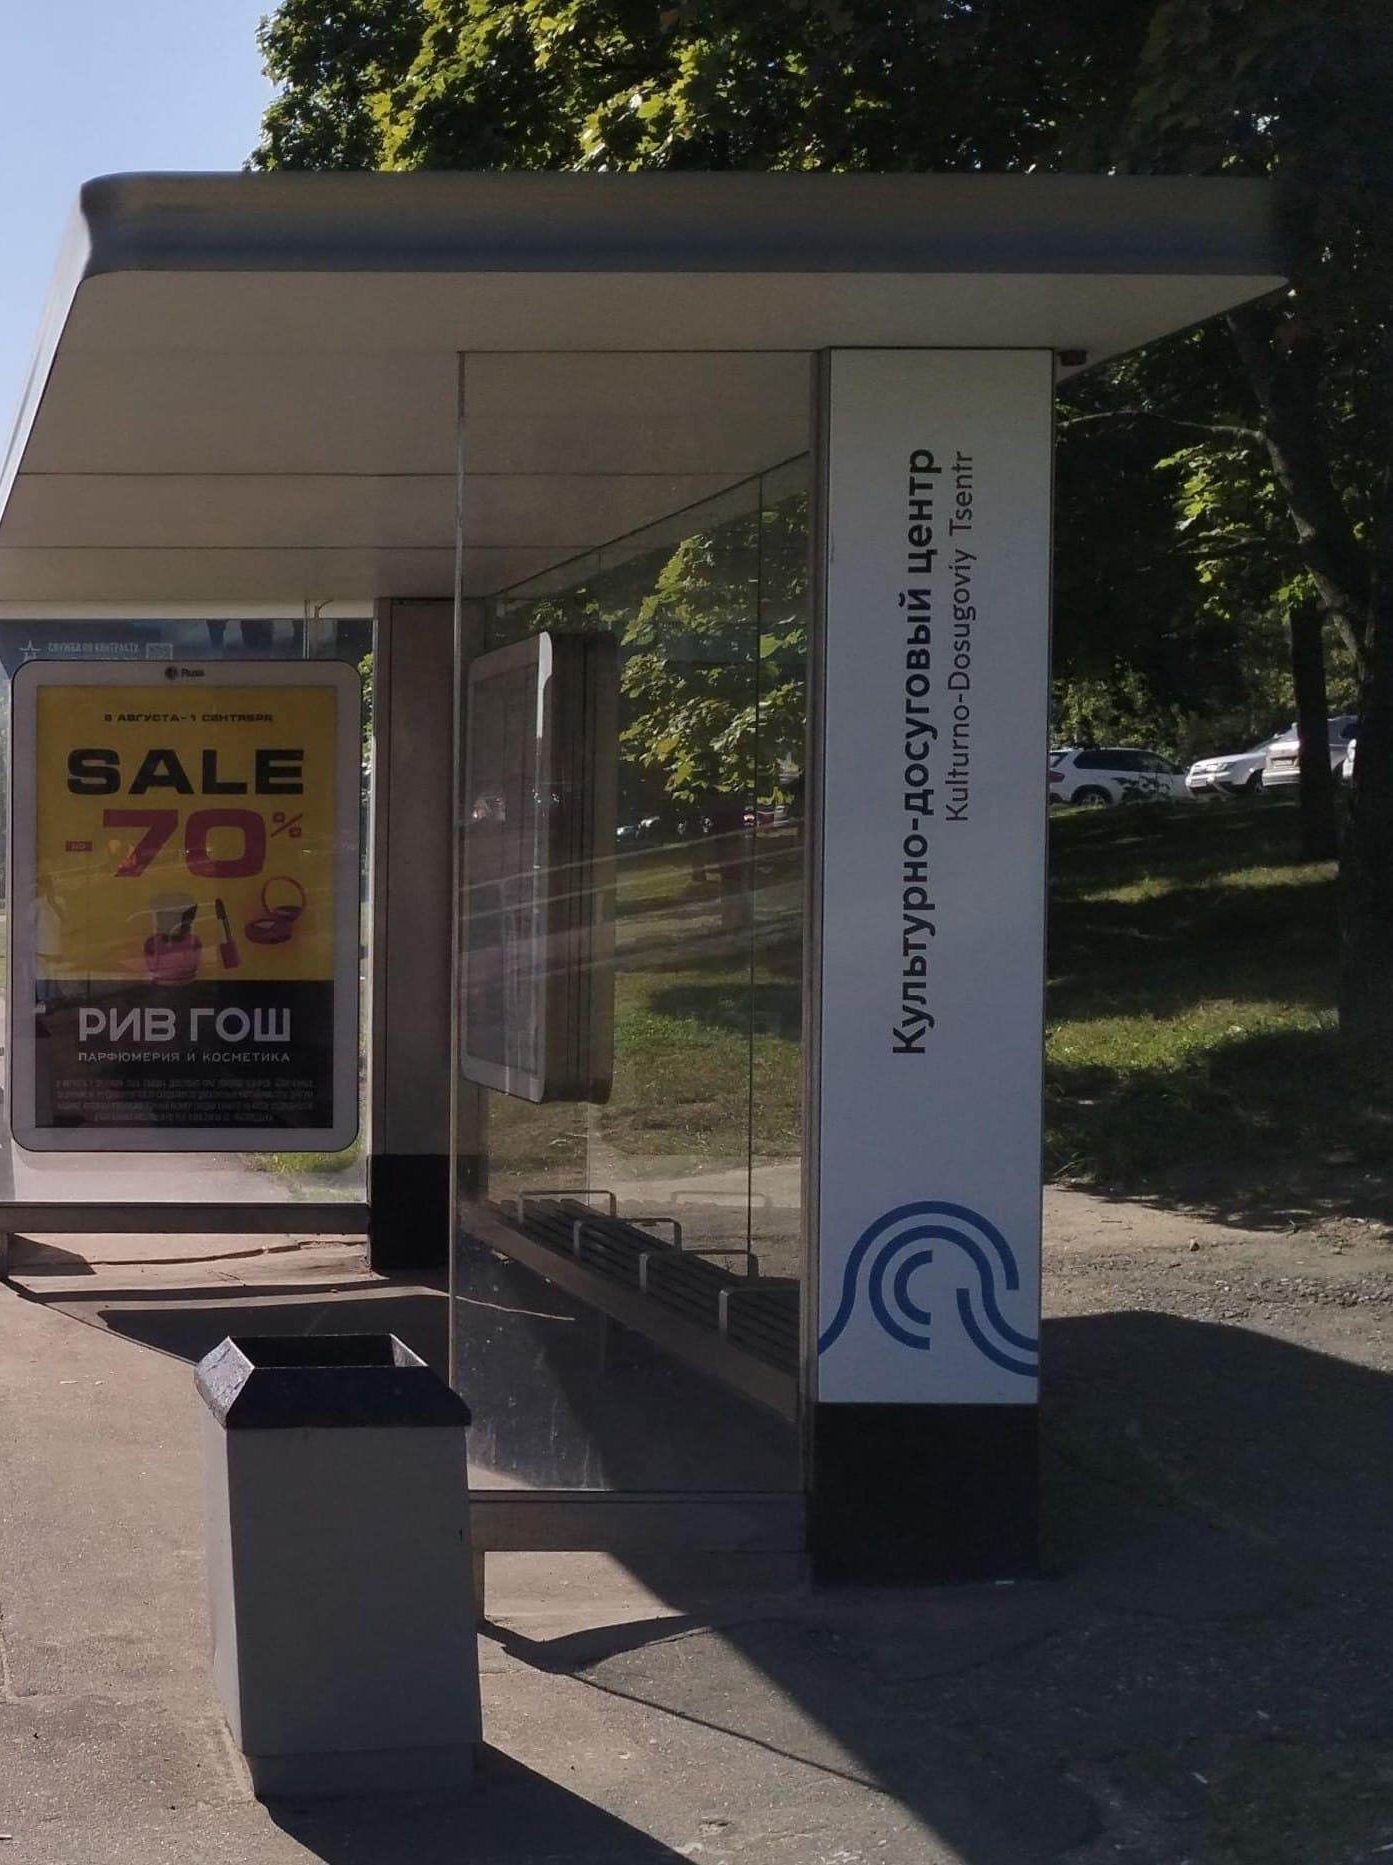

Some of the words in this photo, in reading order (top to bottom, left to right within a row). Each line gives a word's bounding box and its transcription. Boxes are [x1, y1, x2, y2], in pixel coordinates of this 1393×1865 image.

[908, 448, 943, 574] центр
[948, 450, 974, 537] Tsentr
[945, 548, 978, 822] Kulturno-Dosugoviy
[66, 749, 305, 796] SALE
[892, 588, 942, 1055] Культурно-досуговый
[78, 1052, 180, 1062] ПАРФЮМЕРИЯ
[187, 1052, 196, 1062] И
[203, 1052, 290, 1062] КОСМЕТИКА
[79, 1007, 176, 1042] РИВ
[190, 1007, 291, 1042] ГОШ
